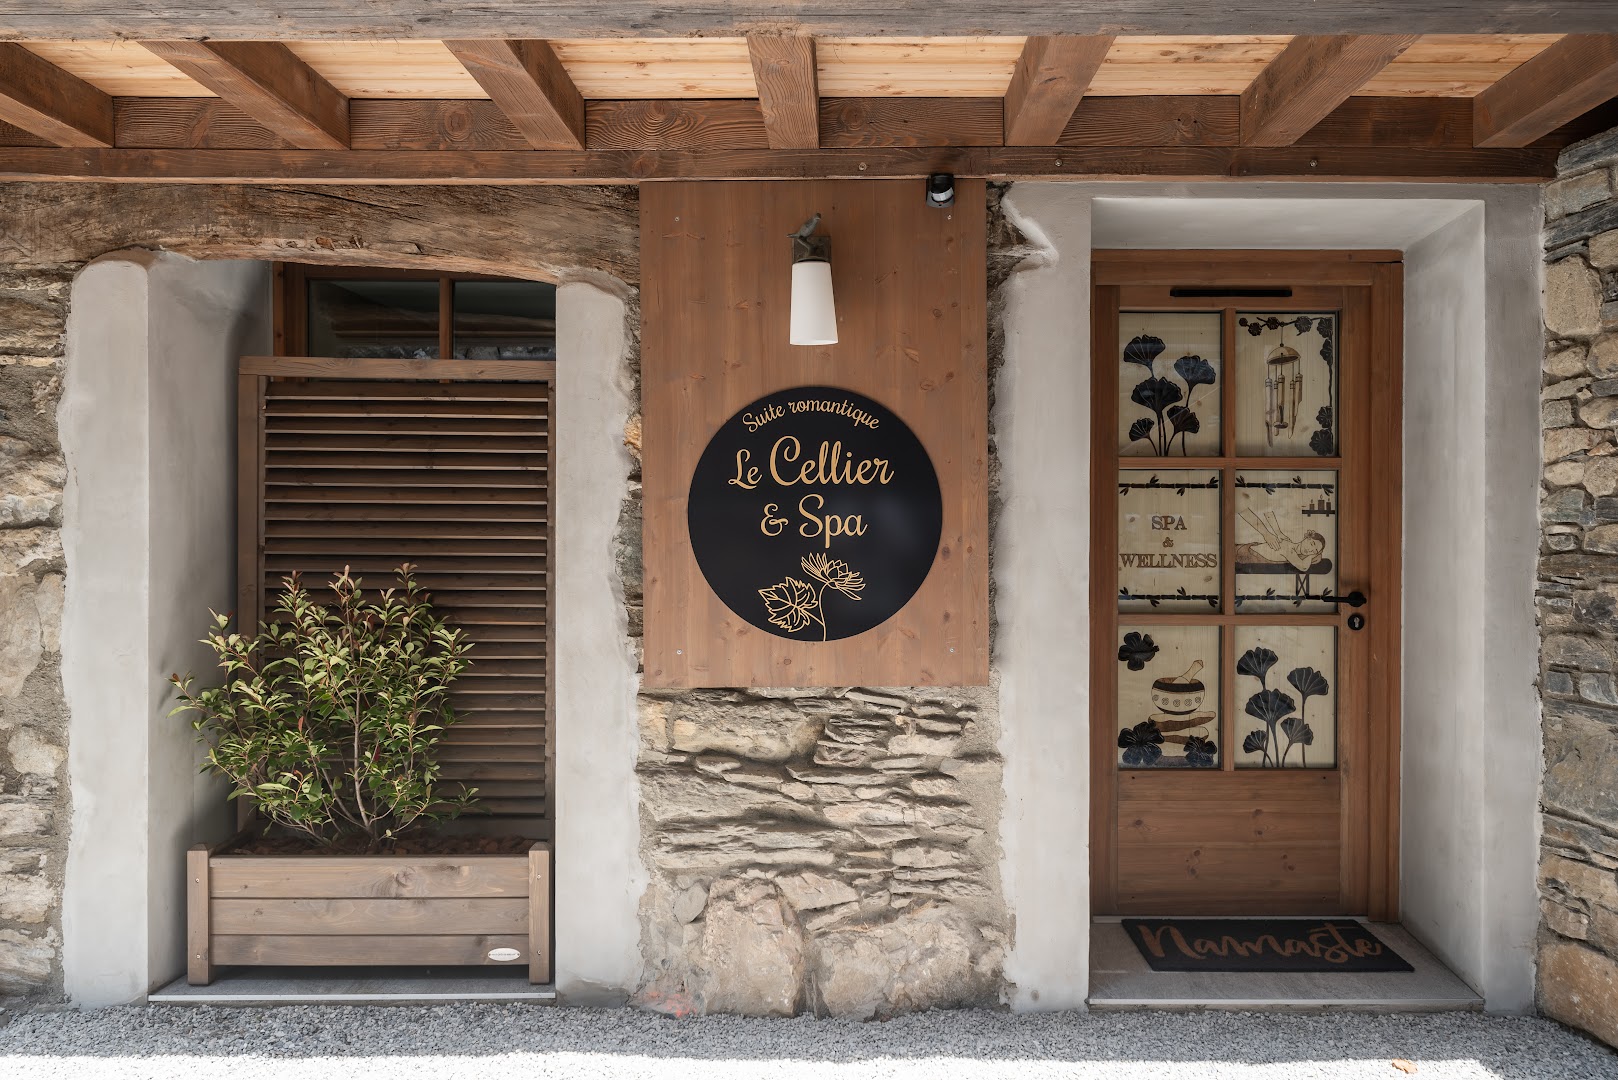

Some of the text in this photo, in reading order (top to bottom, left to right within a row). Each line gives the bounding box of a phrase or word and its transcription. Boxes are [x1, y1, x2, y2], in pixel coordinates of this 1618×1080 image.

[742, 399, 880, 433] Suite romantique
[727, 435, 895, 490] Le Cellier
[760, 493, 868, 549] & Spa
[1151, 515, 1187, 531] SPA
[1162, 536, 1174, 548] &
[1119, 553, 1218, 569] WELLNESS
[1136, 922, 1383, 964] Namaste
